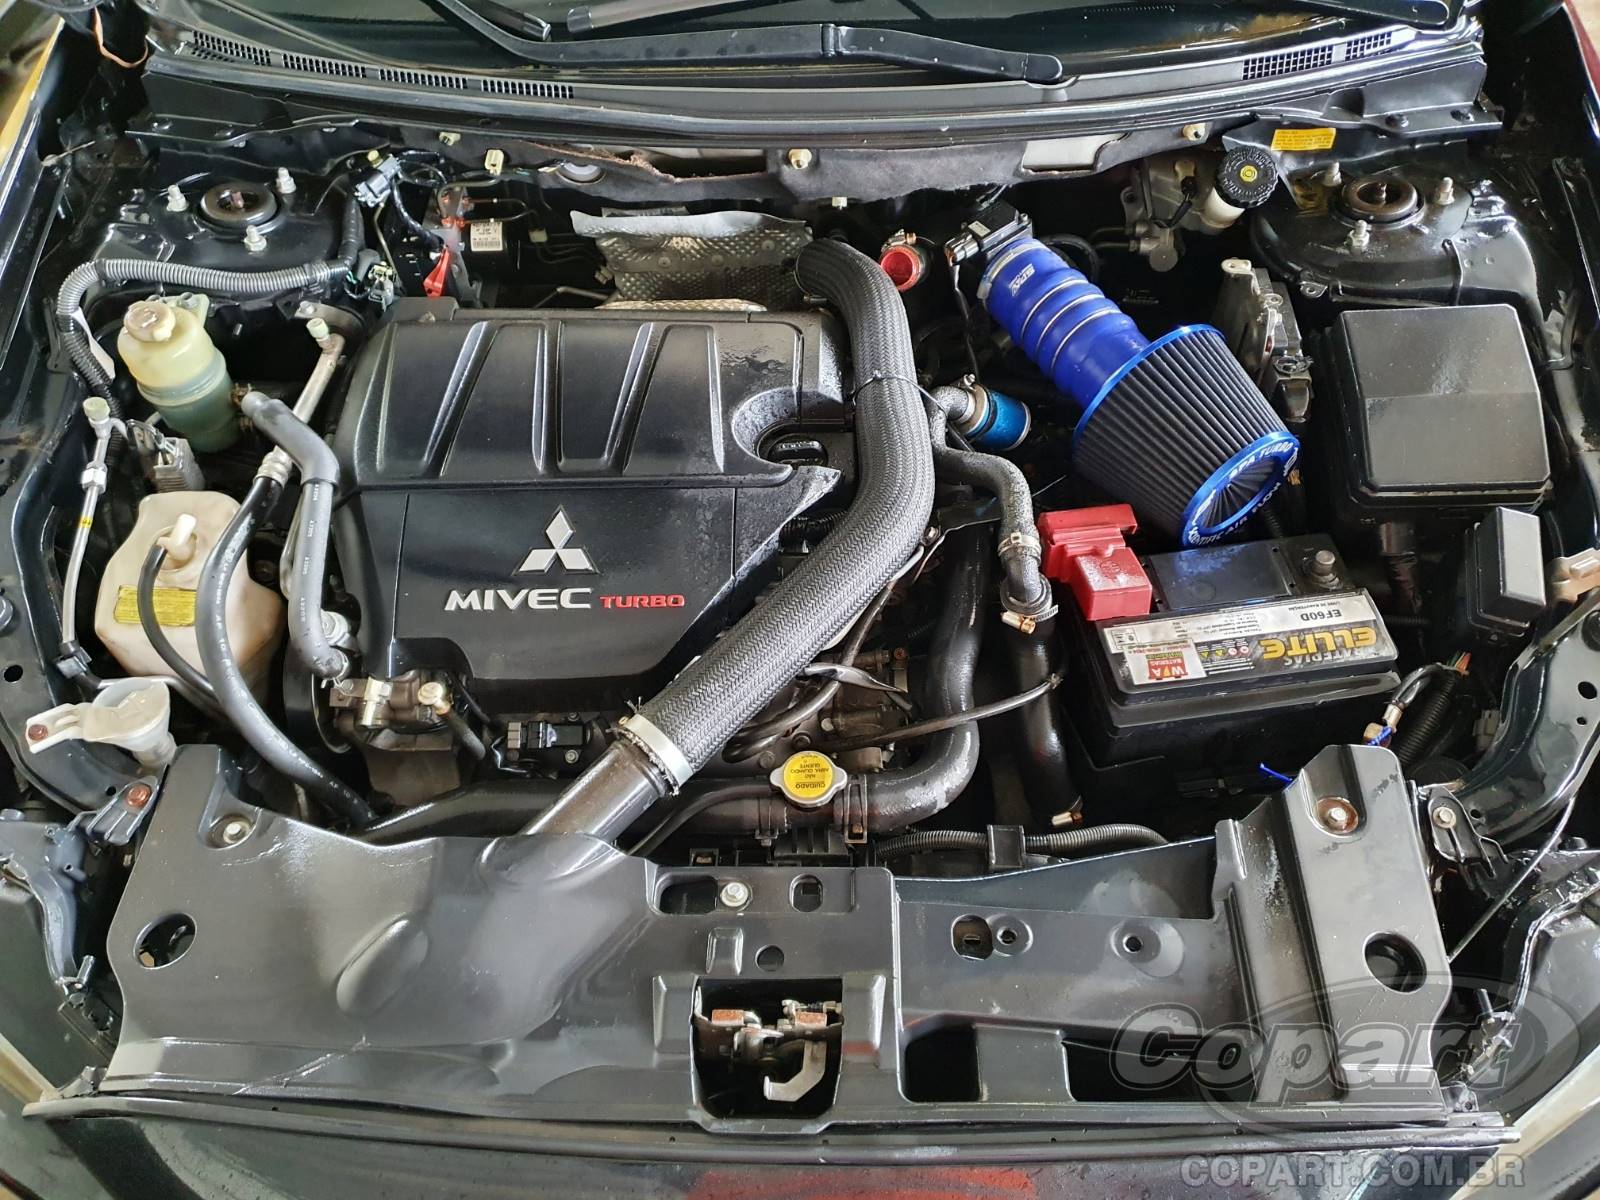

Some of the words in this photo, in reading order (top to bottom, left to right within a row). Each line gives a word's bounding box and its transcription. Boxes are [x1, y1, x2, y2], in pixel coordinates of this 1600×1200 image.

[1259, 441, 1294, 458] TURBO
[444, 588, 592, 611] MIVEC
[600, 594, 685, 609] TURBO
[1300, 609, 1342, 621] EF60D
[1260, 626, 1377, 660] ELLITE
